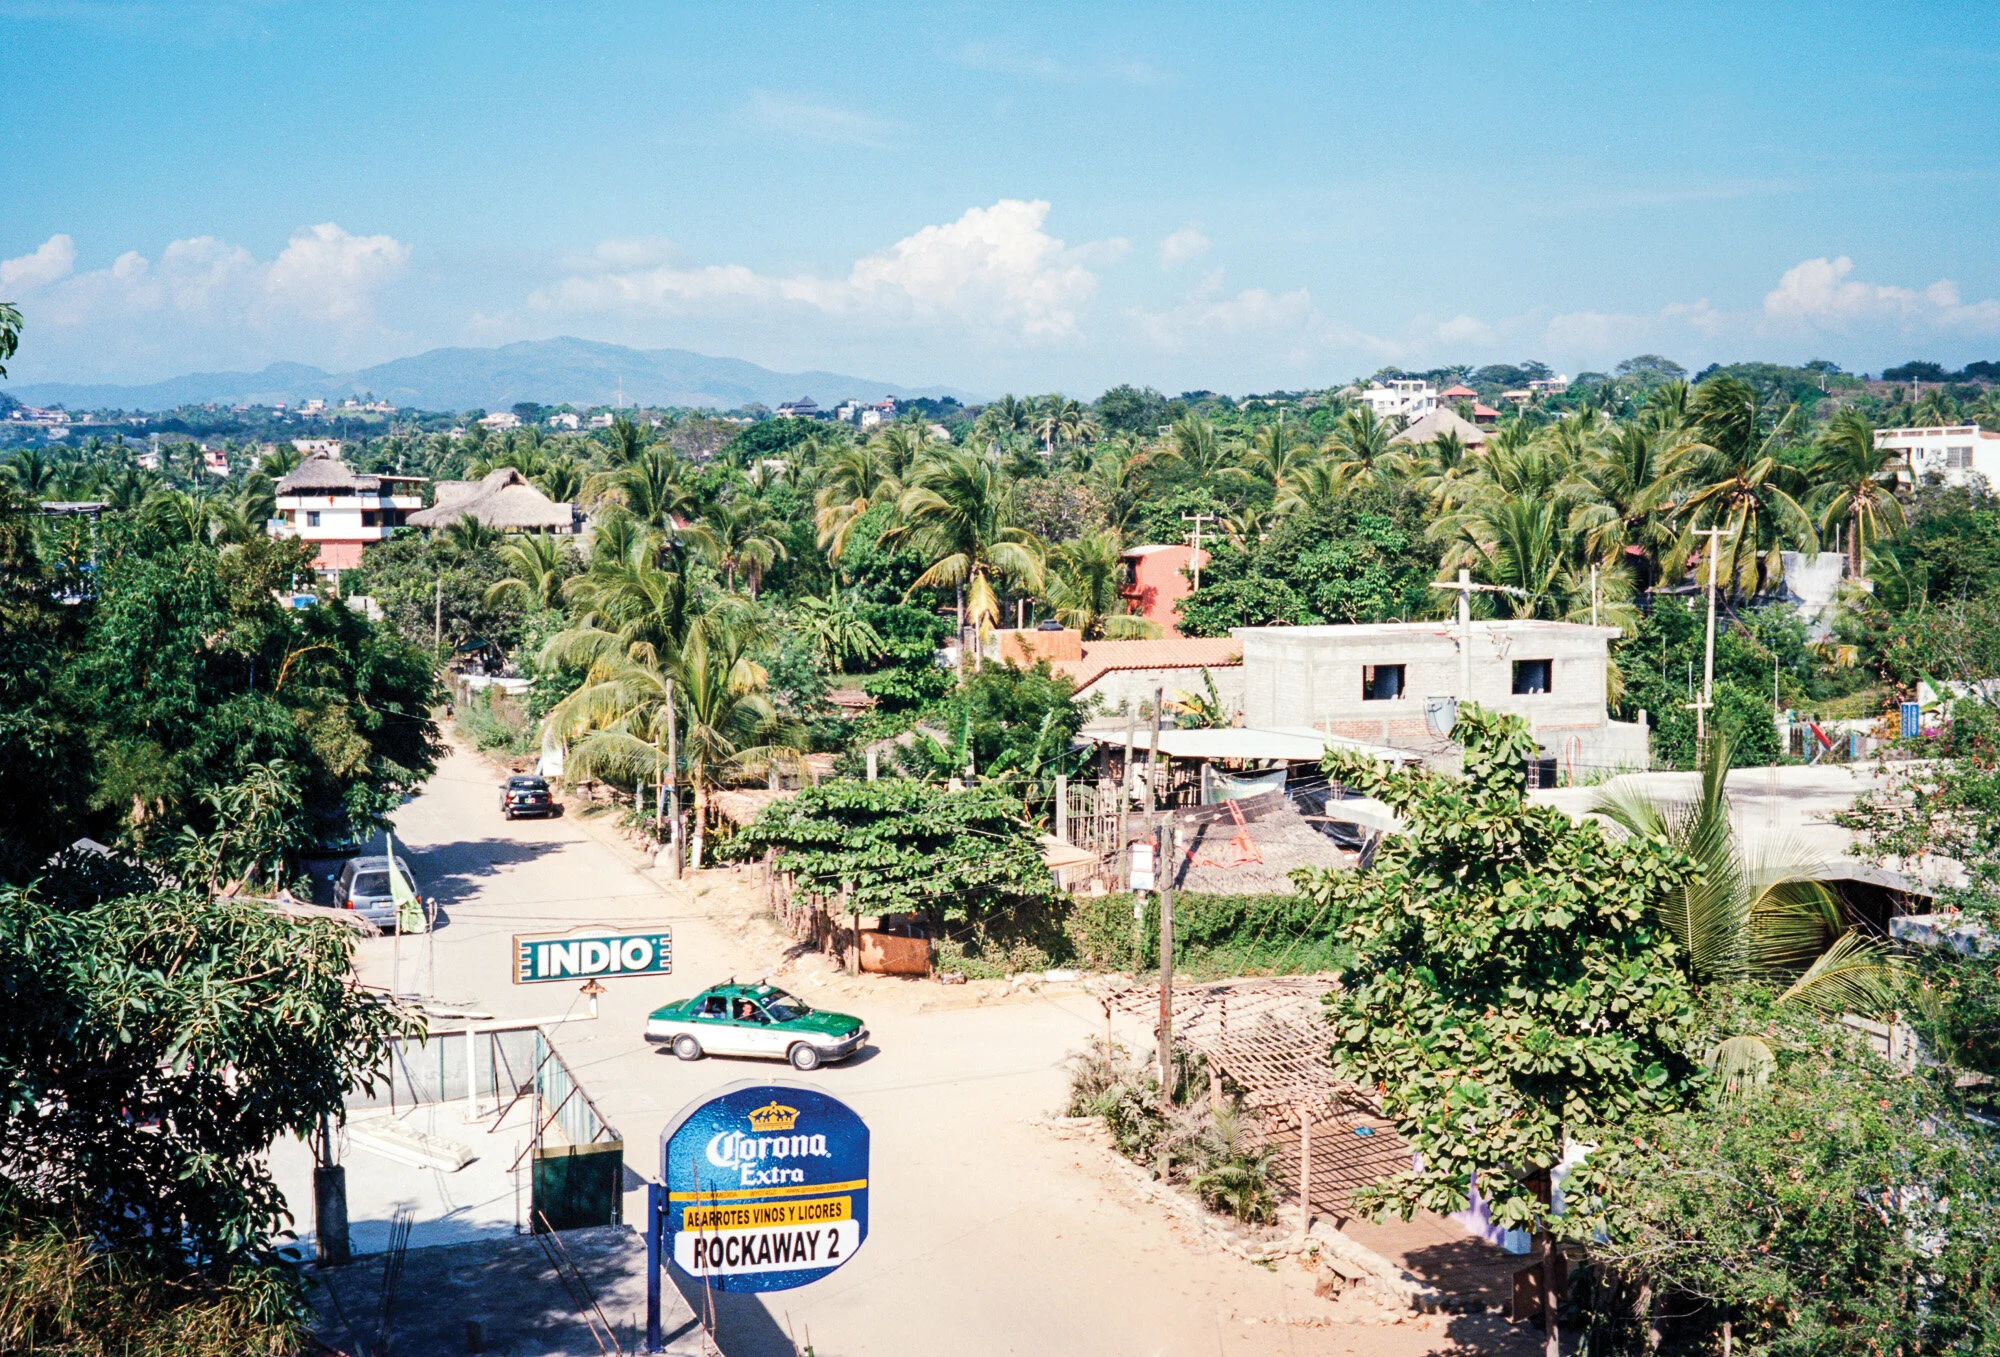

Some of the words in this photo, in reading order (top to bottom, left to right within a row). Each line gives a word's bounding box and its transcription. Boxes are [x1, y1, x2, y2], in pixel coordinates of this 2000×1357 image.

[538, 938, 653, 977] INDIO
[706, 1130, 827, 1170] Corona
[740, 1162, 804, 1185] Extra
[753, 1207, 785, 1224] VINOS
[789, 1206, 795, 1220] Y
[798, 1202, 842, 1220] LICORES
[694, 1230, 820, 1269] ROCKAWAY
[827, 1228, 840, 1259] 2
